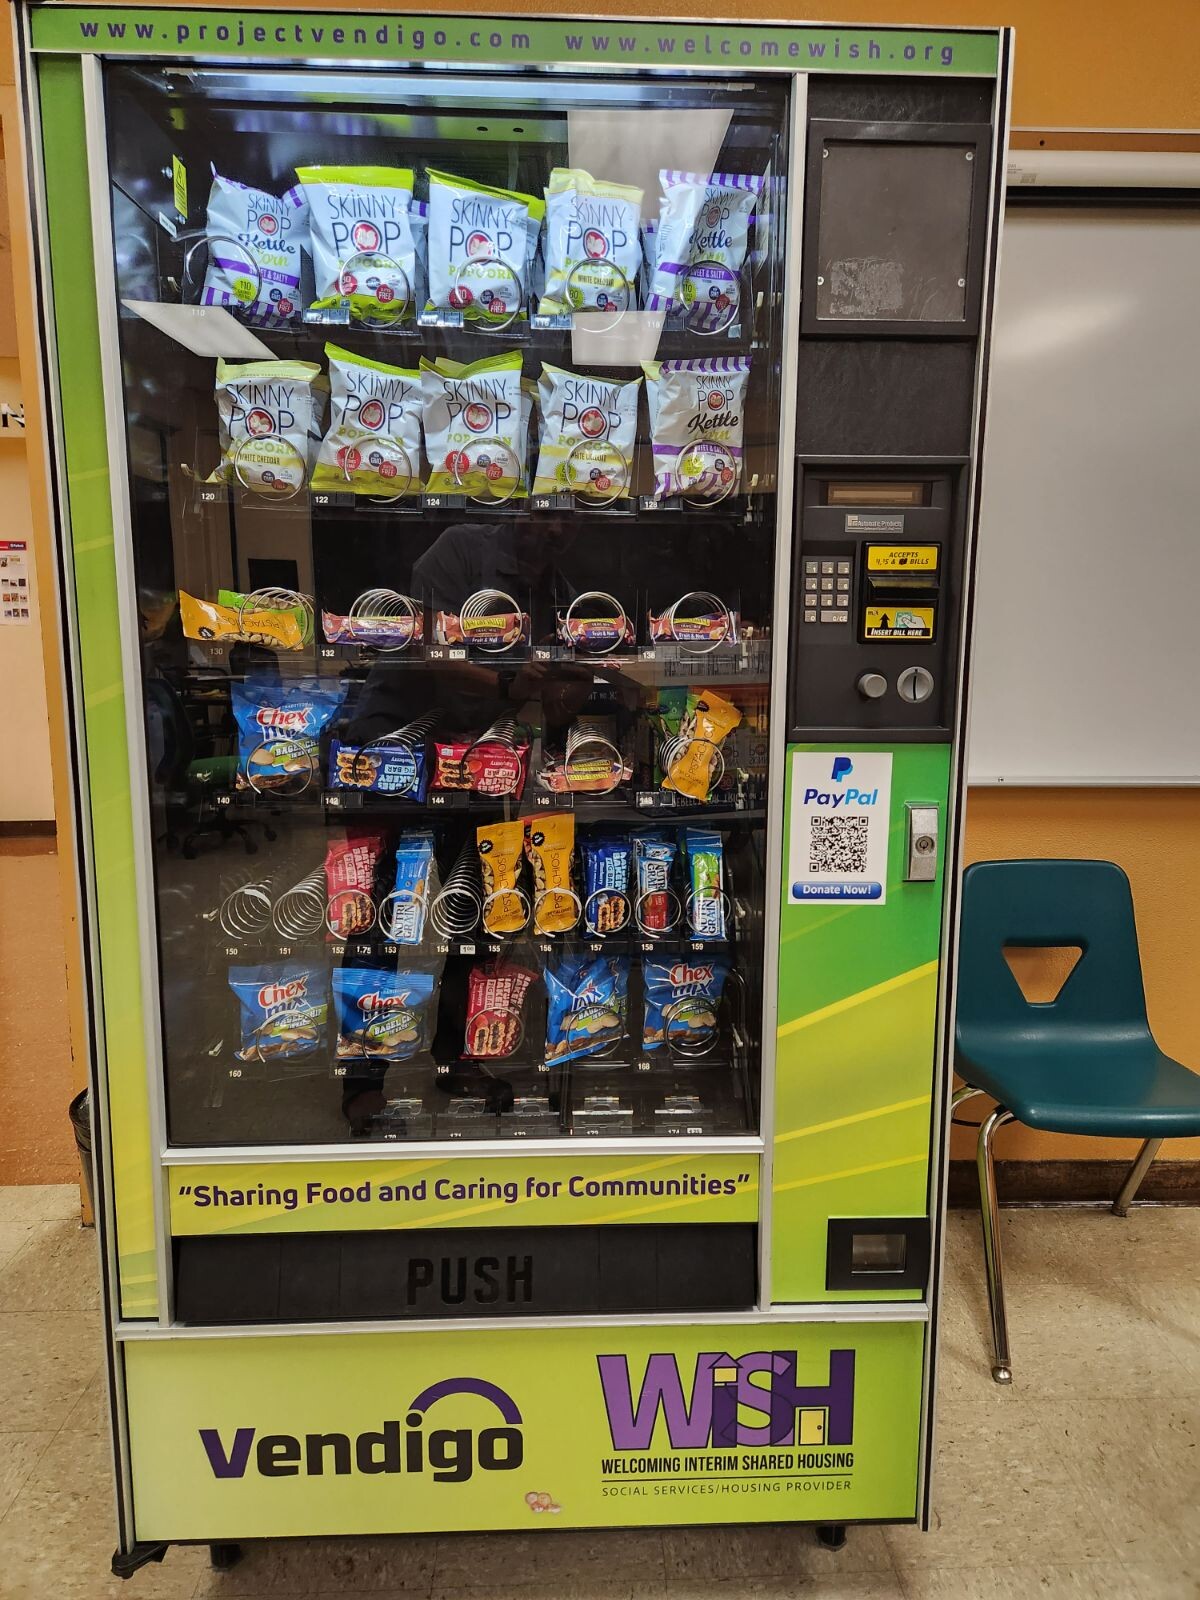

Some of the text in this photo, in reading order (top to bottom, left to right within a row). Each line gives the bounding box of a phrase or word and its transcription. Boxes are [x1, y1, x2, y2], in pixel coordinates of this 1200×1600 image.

[80, 20, 530, 50] www.projectvendigo.com
[565, 33, 954, 65] www.welcomewish.org
[247, 209, 291, 238] POP
[451, 198, 513, 229] SKINNY
[701, 203, 730, 229] POP
[332, 219, 401, 258] POP
[450, 226, 513, 266] POP
[567, 220, 627, 262] POP
[689, 229, 732, 254] Kettle
[490, 304, 505, 314] FREE
[346, 371, 413, 401] SKINNY
[443, 379, 507, 402] SKINNY
[696, 375, 732, 390] SKINNY
[226, 380, 295, 408] SKINNY
[564, 380, 621, 410] SKINNY
[698, 390, 735, 411] POP
[229, 405, 295, 442] POP
[341, 394, 403, 434] POP
[447, 402, 511, 434] POP
[560, 402, 622, 441] POP
[688, 411, 739, 434] Kettle
[381, 467, 394, 476] FREE
[426, 498, 440, 506] 124
[871, 628, 892, 637] INSERT
[906, 629, 924, 637] HERE
[210, 648, 223, 656] 130
[321, 649, 335, 658] 132
[430, 651, 443, 659] 134
[257, 706, 311, 727] Chex
[388, 766, 402, 774] BAR
[325, 797, 339, 805] 142
[803, 788, 878, 809] PayPal
[352, 847, 366, 890] BAKERY
[803, 884, 871, 895] Donate Now!
[395, 903, 405, 939] NUTRI
[403, 903, 415, 939] GRAIN
[708, 900, 716, 934] GRAIN
[225, 948, 238, 956] 150
[279, 947, 291, 955] 151
[357, 946, 371, 954] 1.75
[437, 945, 449, 953] 154
[691, 943, 703, 951] 159
[671, 963, 714, 985] Chex
[259, 976, 309, 1007] Chex
[358, 991, 411, 1010] Chex
[672, 983, 711, 998] mix
[266, 997, 305, 1017] mix
[374, 1019, 401, 1036] BAGEL
[229, 1070, 242, 1078] 160
[307, 1182, 371, 1203] Food
[379, 1180, 426, 1201] and
[434, 1177, 518, 1203] Caring
[526, 1177, 562, 1198] for
[407, 1256, 533, 1305] PUSH
[198, 1412, 524, 1482] Vendigo
[601, 1452, 854, 1474] WELCOMING INTERIM SHARED HOUSING
[602, 1480, 851, 1497] SOCIAL SERVICES/HOUSING PROVIDER
